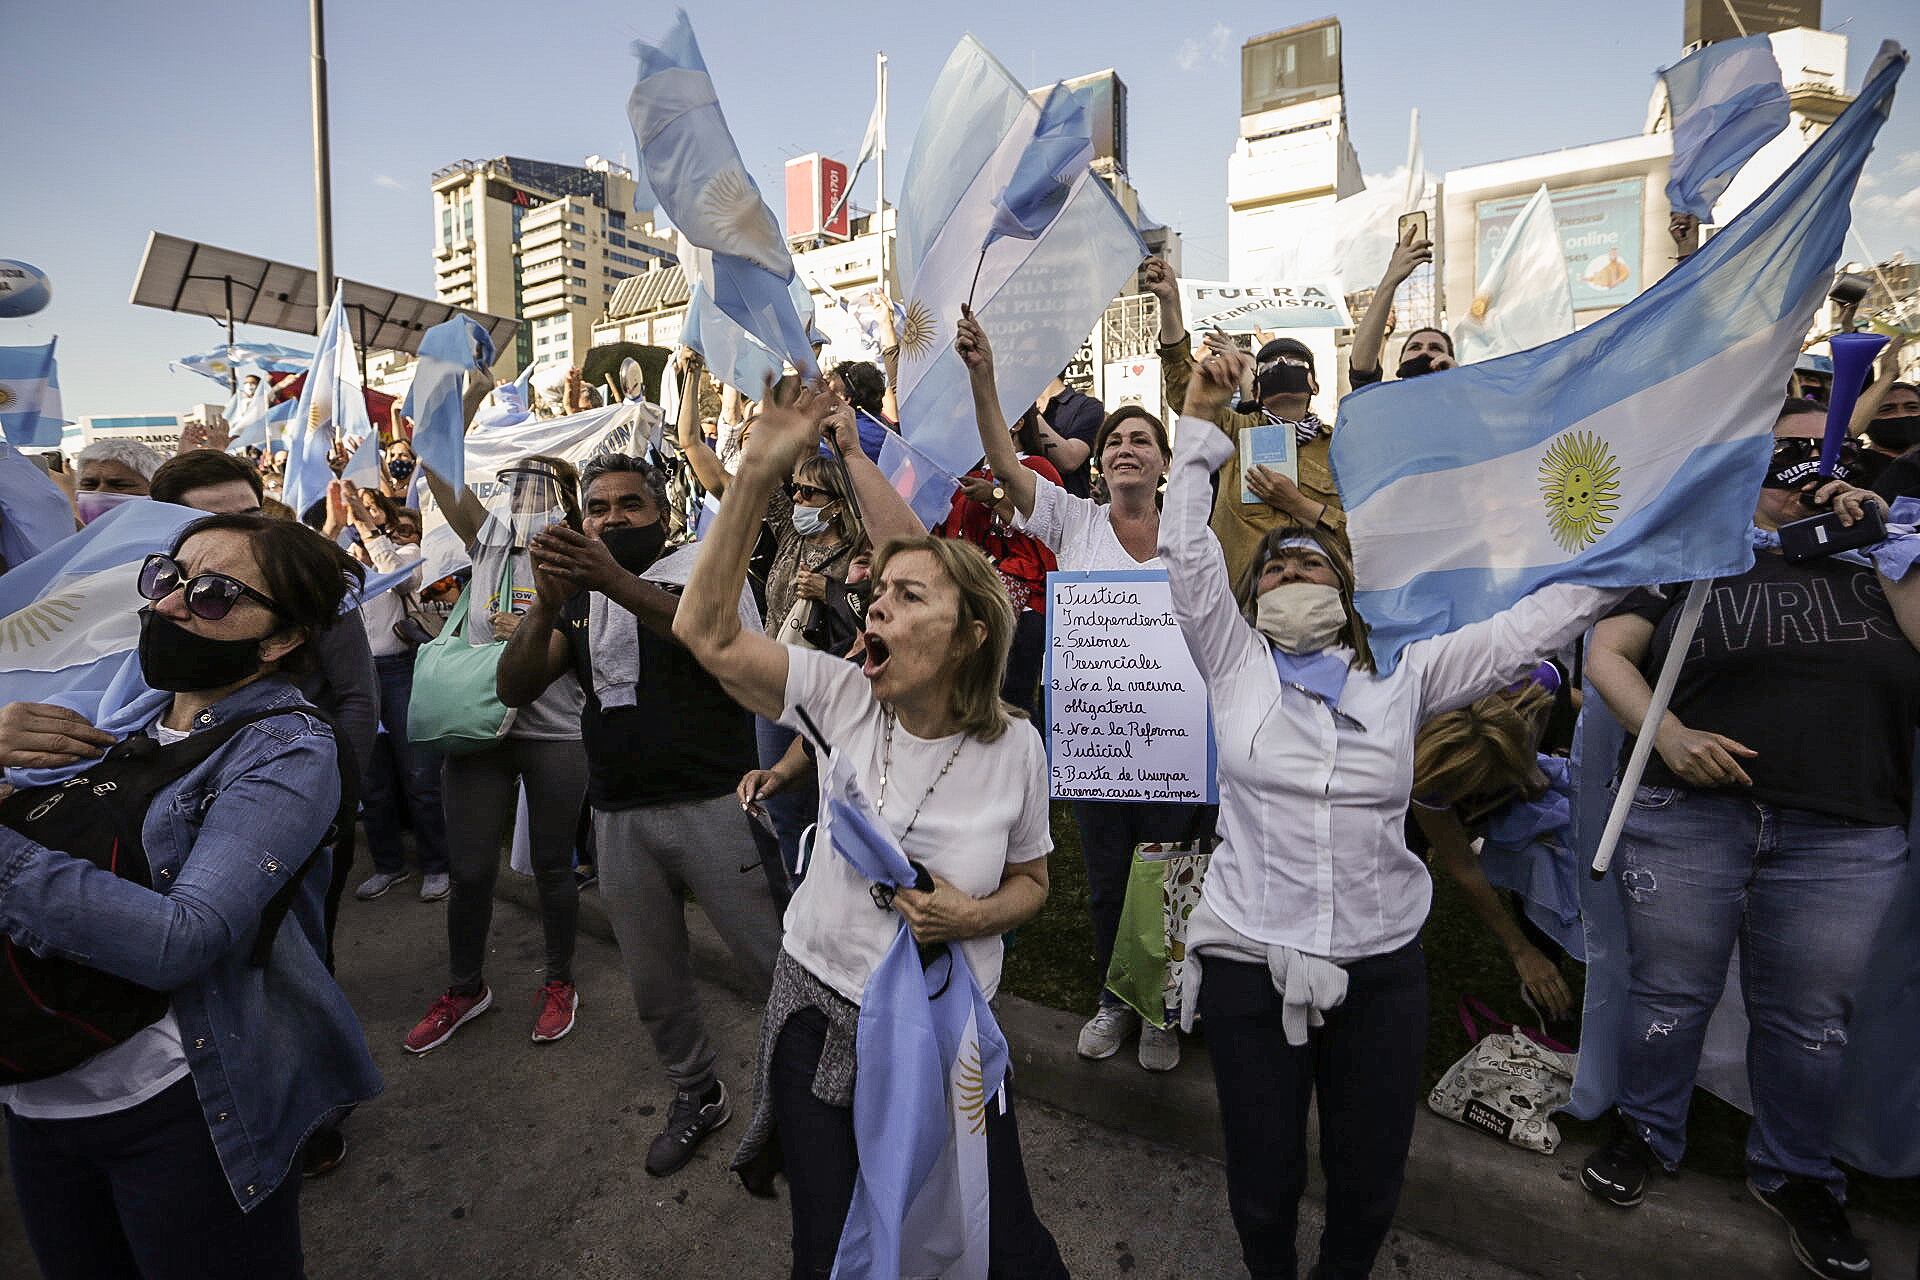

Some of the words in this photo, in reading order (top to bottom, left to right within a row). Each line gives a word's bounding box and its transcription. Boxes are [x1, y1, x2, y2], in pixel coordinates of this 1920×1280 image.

[1566, 231, 1619, 250] online
[1196, 286, 1327, 300] FUERA
[1121, 366, 1129, 378] I
[1063, 608, 1177, 631] Independiente
[1053, 636, 1064, 648] 2.
[1067, 629, 1131, 649] Sesiones
[1062, 650, 1162, 670] Presenciales
[1051, 679, 1062, 691] 3.
[1064, 677, 1089, 692] No
[1090, 681, 1102, 692] a
[1107, 676, 1125, 692] la
[1128, 680, 1186, 692] vacuna
[1064, 698, 1147, 720] obligatoria
[1052, 722, 1064, 734] 4.
[1067, 722, 1089, 736] No
[1090, 726, 1104, 736] a
[1108, 721, 1128, 736] la
[1128, 721, 1189, 746] Reforma
[1061, 739, 1134, 759] Judicial
[1052, 766, 1063, 778] 5.
[1064, 765, 1113, 783] Basta
[1117, 767, 1134, 781] de
[1137, 768, 1190, 790] Usurpar
[1152, 788, 1201, 802] campos
[1469, 1111, 1504, 1135] norma
